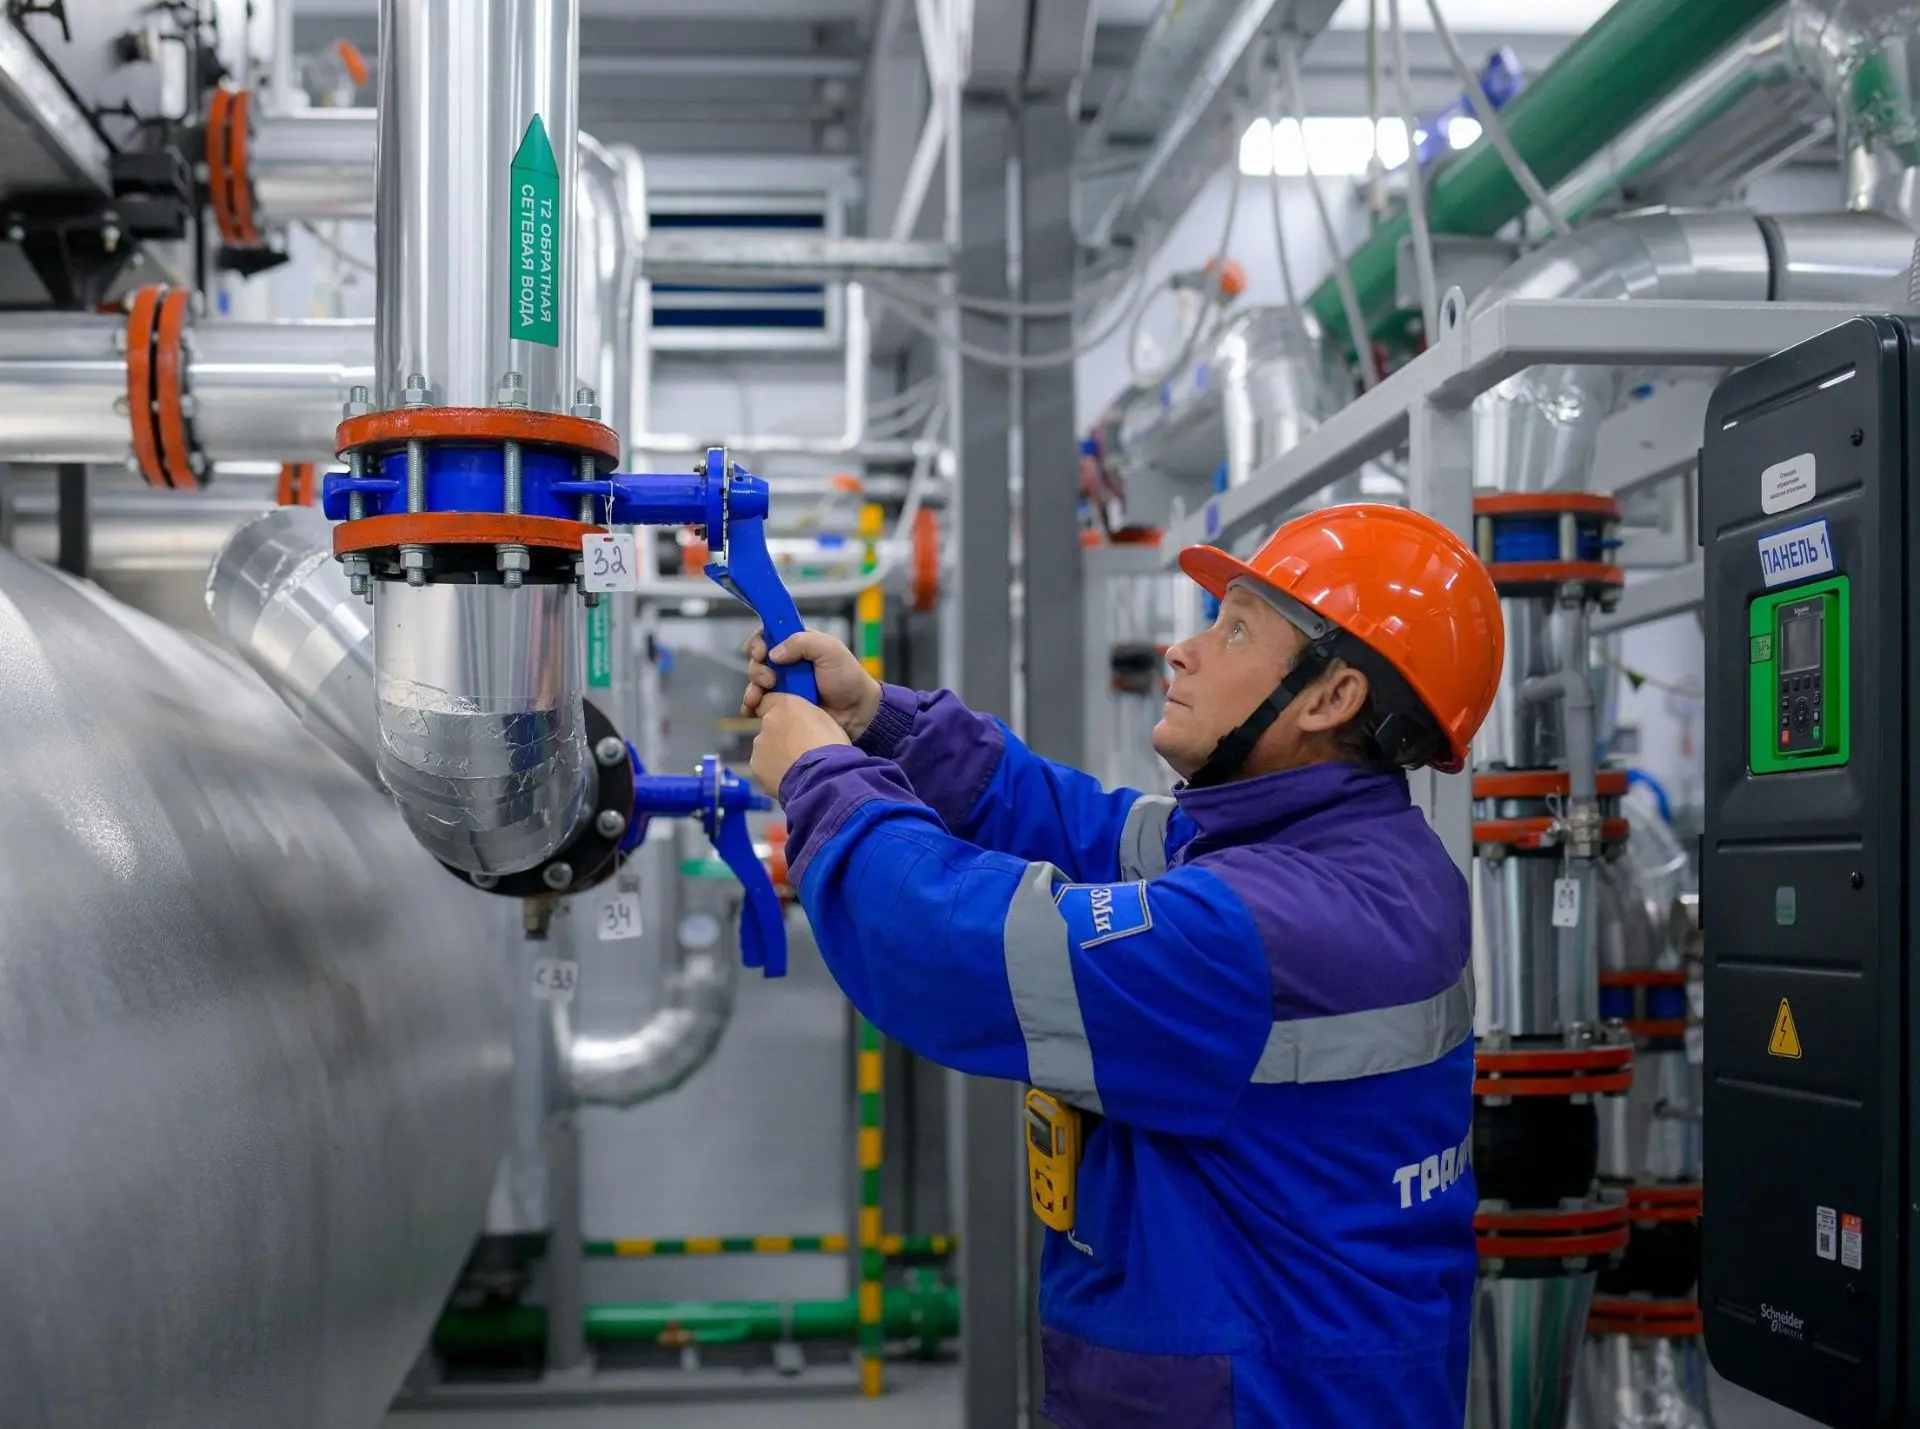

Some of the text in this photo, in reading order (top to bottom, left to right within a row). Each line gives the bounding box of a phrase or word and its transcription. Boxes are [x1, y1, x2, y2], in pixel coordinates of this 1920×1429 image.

[519, 184, 535, 327] СЕТЕВАЯ ВОДА
[540, 224, 552, 322] ОБРАТНАЯ
[593, 545, 627, 576] 32
[1761, 532, 1829, 576] ПАНЕЛЬ 1
[603, 903, 632, 931] 34
[1760, 1302, 1805, 1331] Schneider
